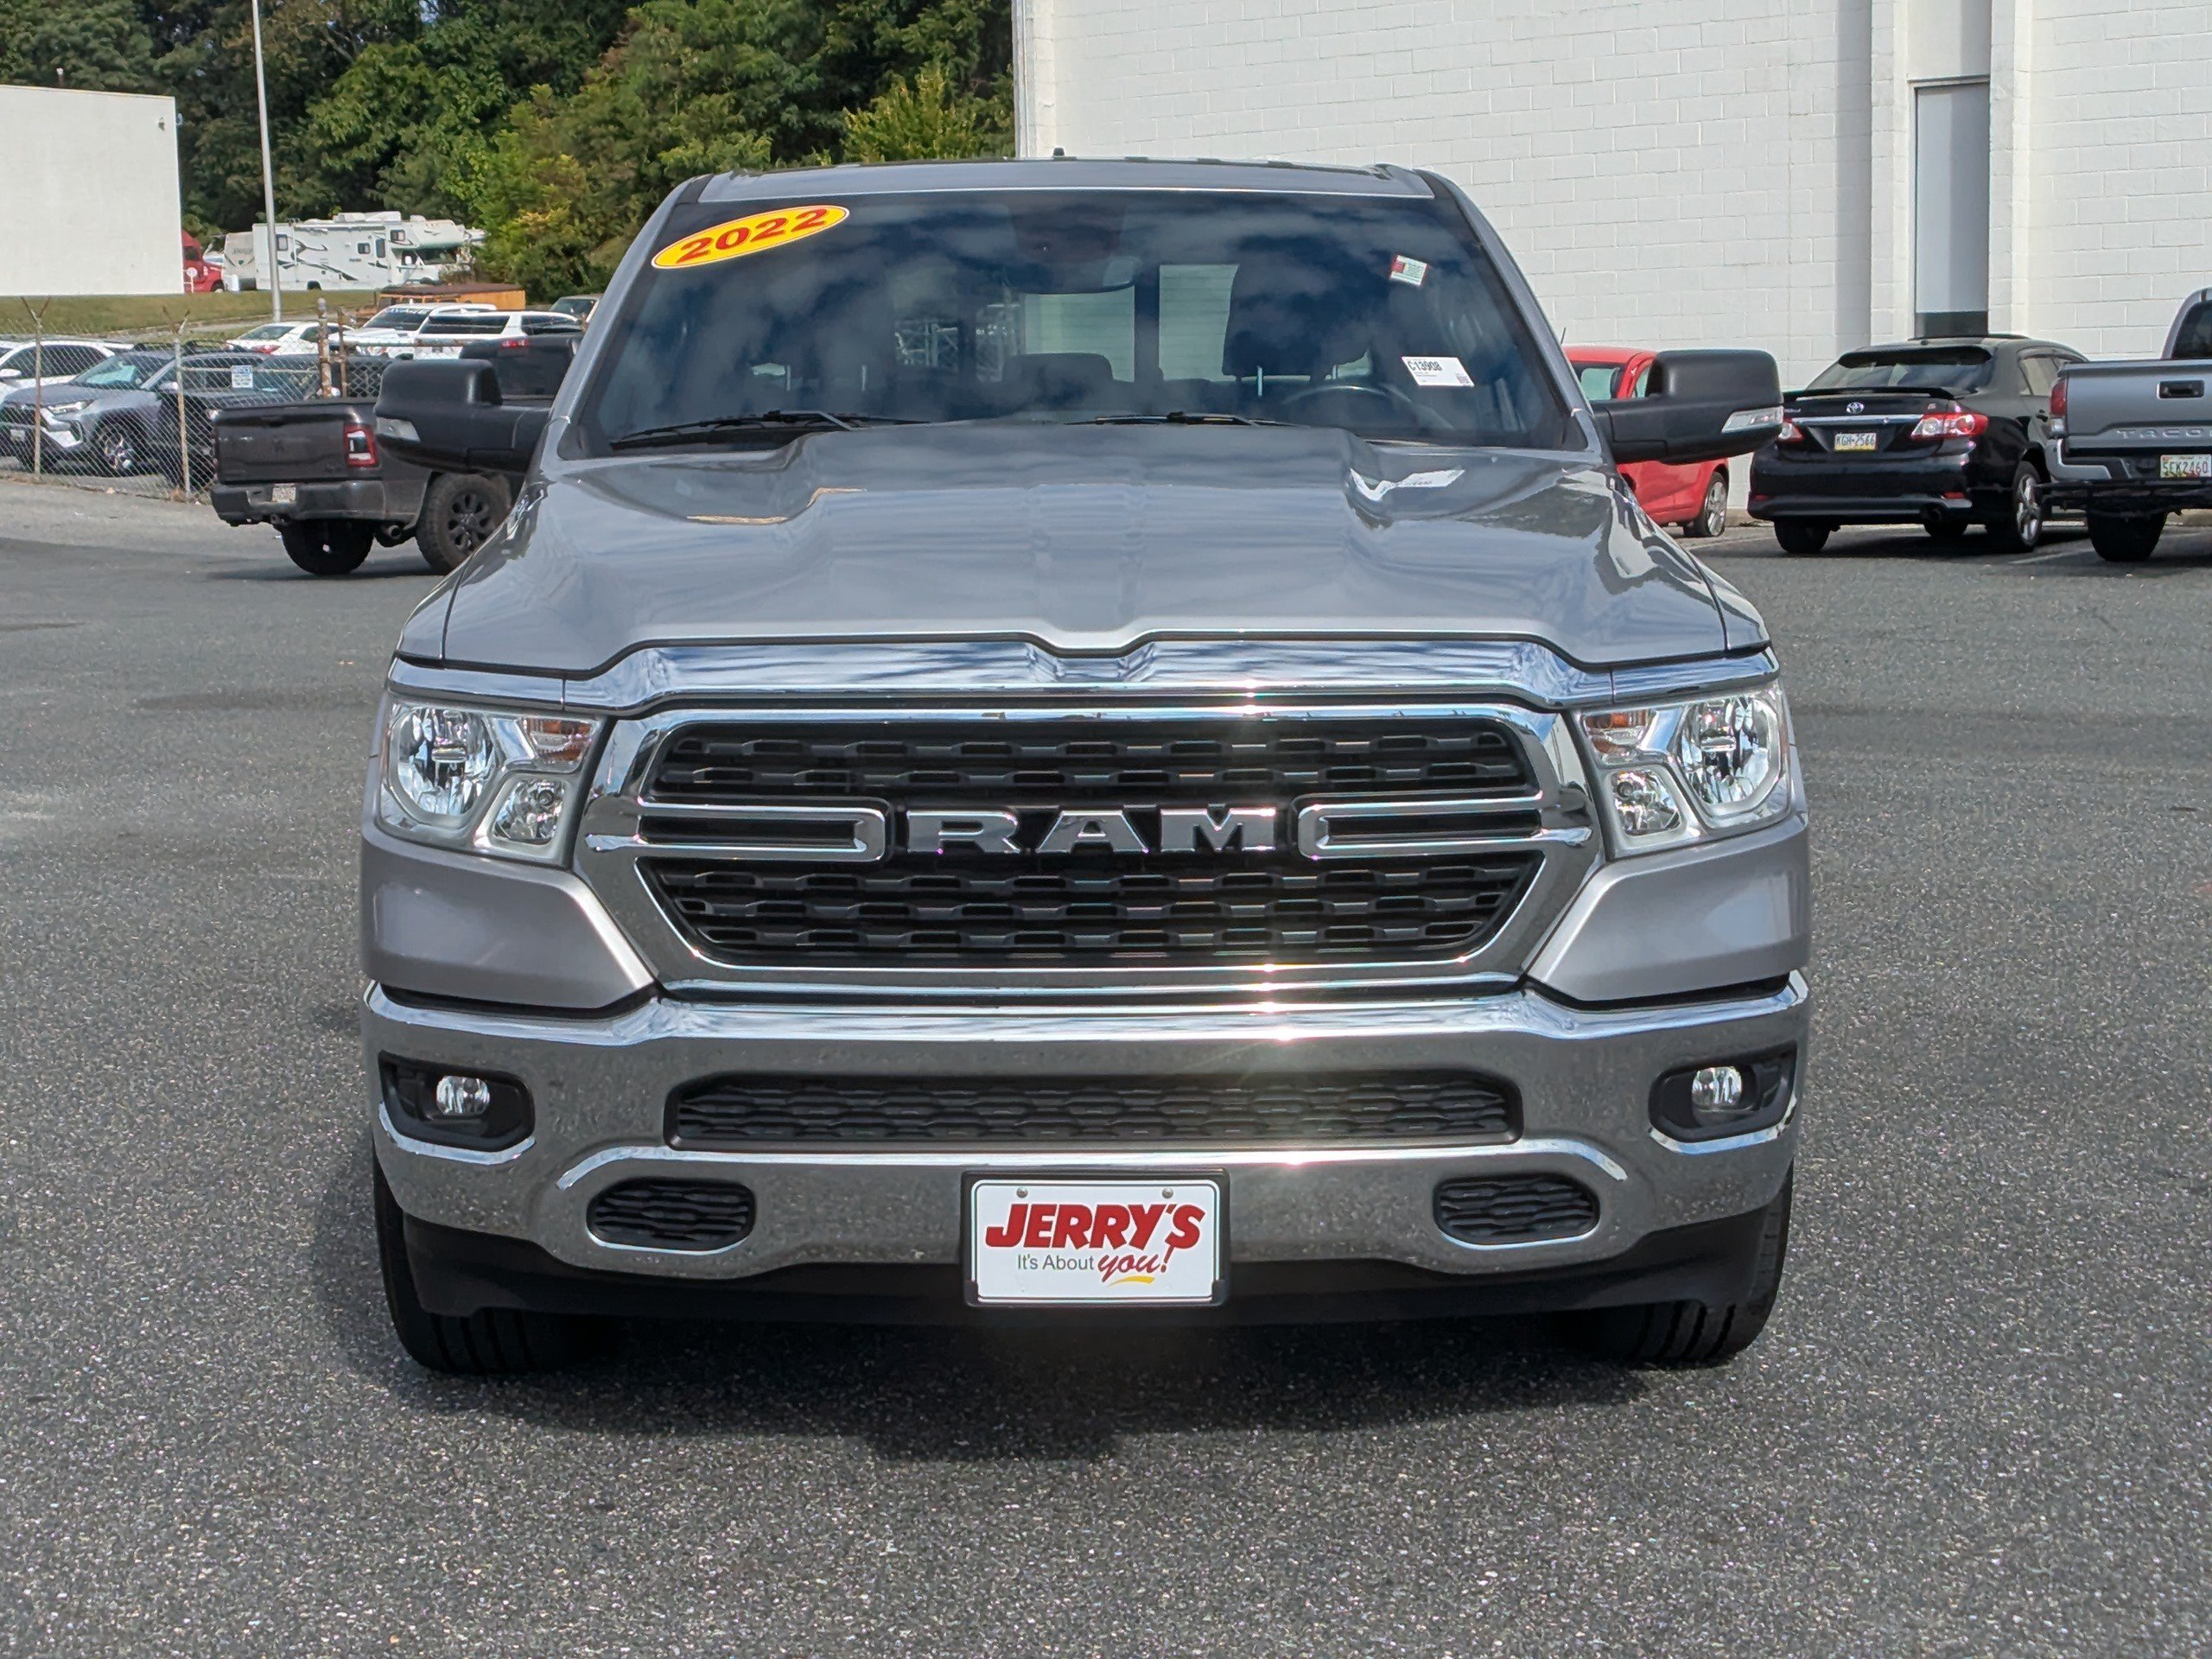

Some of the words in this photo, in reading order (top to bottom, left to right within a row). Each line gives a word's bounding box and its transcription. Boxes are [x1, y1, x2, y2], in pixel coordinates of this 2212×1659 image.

[676, 208, 830, 264] 2022
[2116, 427, 2212, 439] TACO
[906, 808, 1277, 854] RAM
[984, 1203, 1206, 1250] JERRY'S
[1017, 1254, 1039, 1270] It's
[1042, 1254, 1094, 1270] About
[1096, 1244, 1175, 1282] you!
